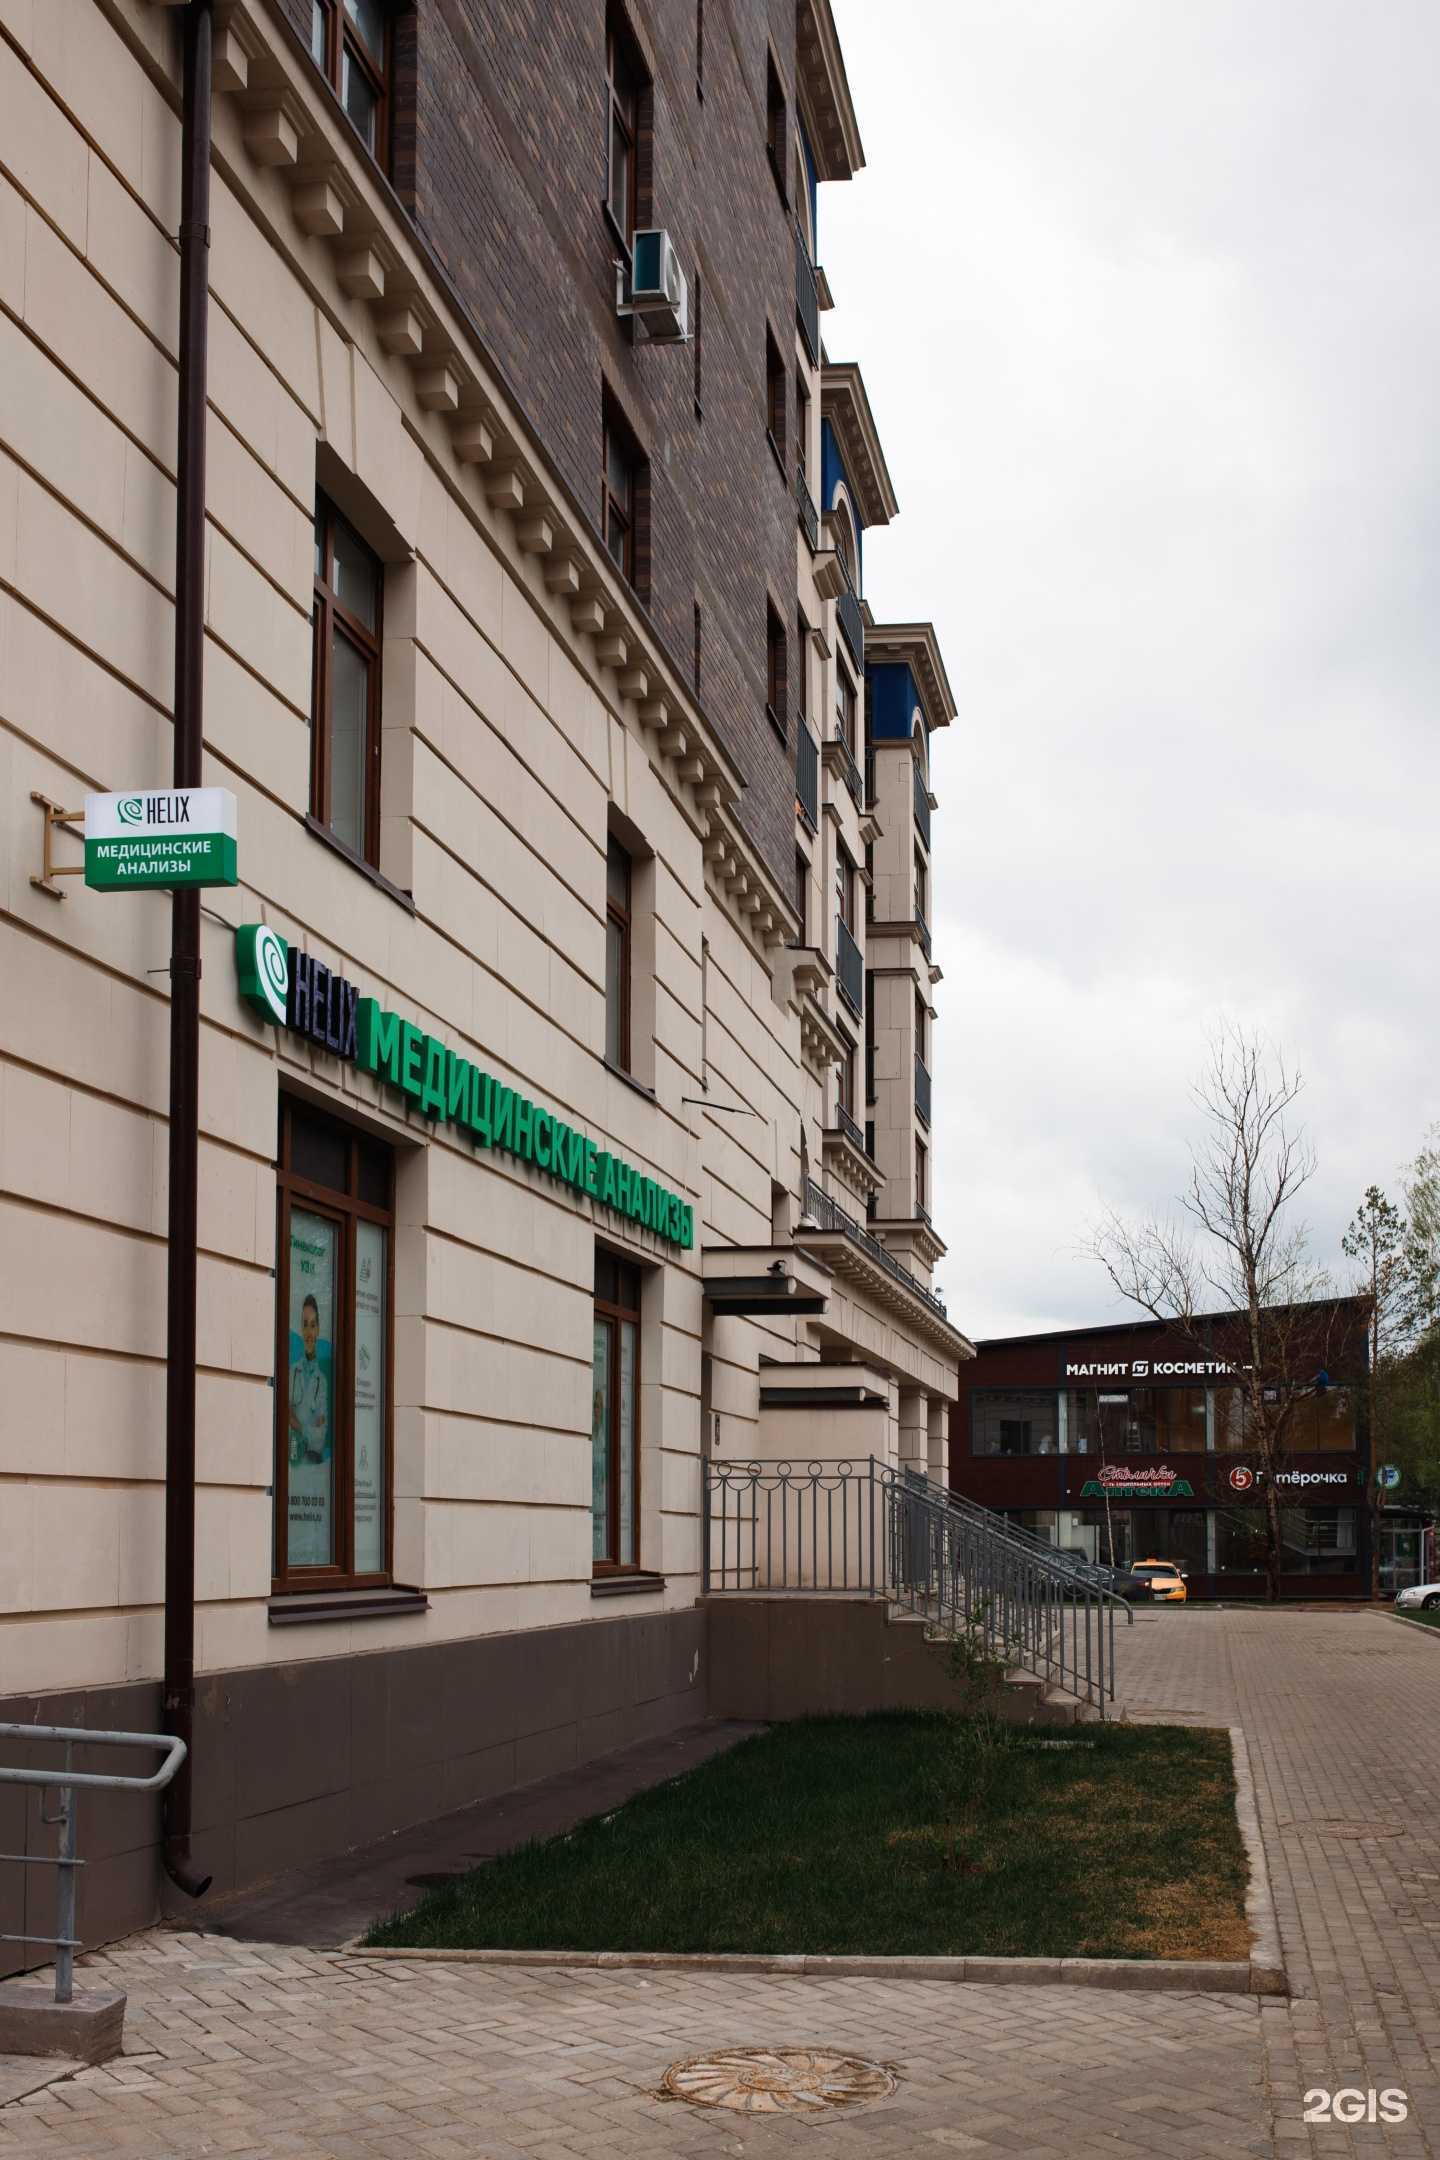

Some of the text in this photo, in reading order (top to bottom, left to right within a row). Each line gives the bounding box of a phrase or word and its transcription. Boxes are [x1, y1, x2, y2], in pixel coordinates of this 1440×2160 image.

[147, 796, 190, 824] HELIX
[97, 840, 212, 860] МЕДИЦИНСКИЕ
[117, 860, 191, 876] АНАЛИЗЫ
[287, 947, 694, 1250] HELIX МЕДИЦИНСКИЕ АНАЛИЗЫ
[1066, 1363, 1128, 1376] МАГНИТ
